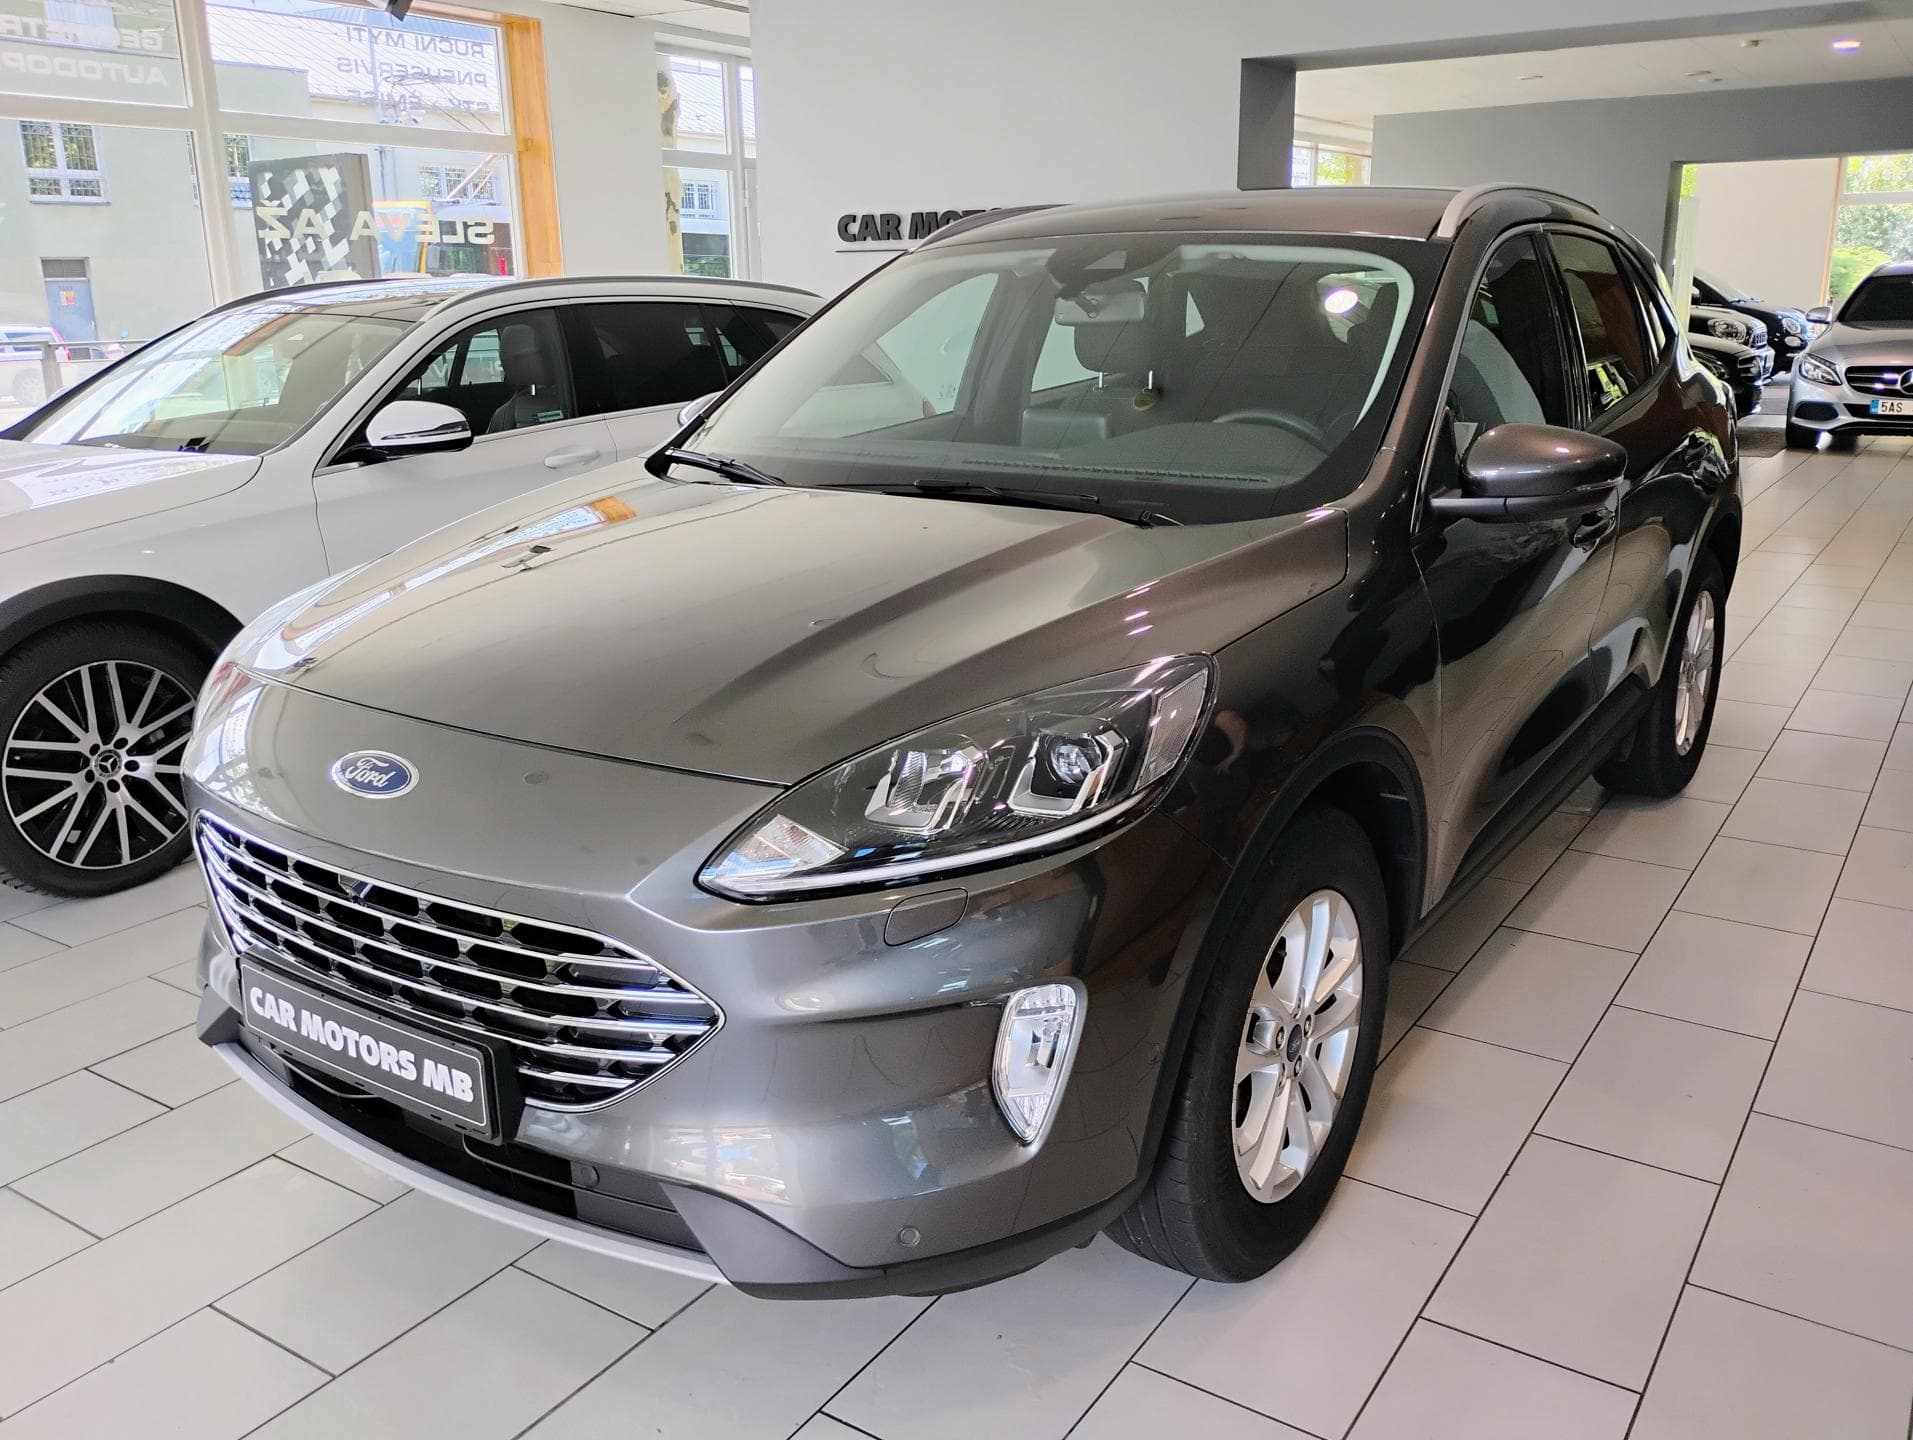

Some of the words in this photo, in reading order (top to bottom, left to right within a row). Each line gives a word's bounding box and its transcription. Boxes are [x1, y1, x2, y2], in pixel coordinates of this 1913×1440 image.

[837, 213, 903, 242] CAR
[1881, 401, 1904, 413] 5AS
[345, 757, 397, 788] Ford
[250, 986, 298, 1032] CAR
[301, 1008, 417, 1081] MOTORS
[422, 1058, 475, 1103] MB
